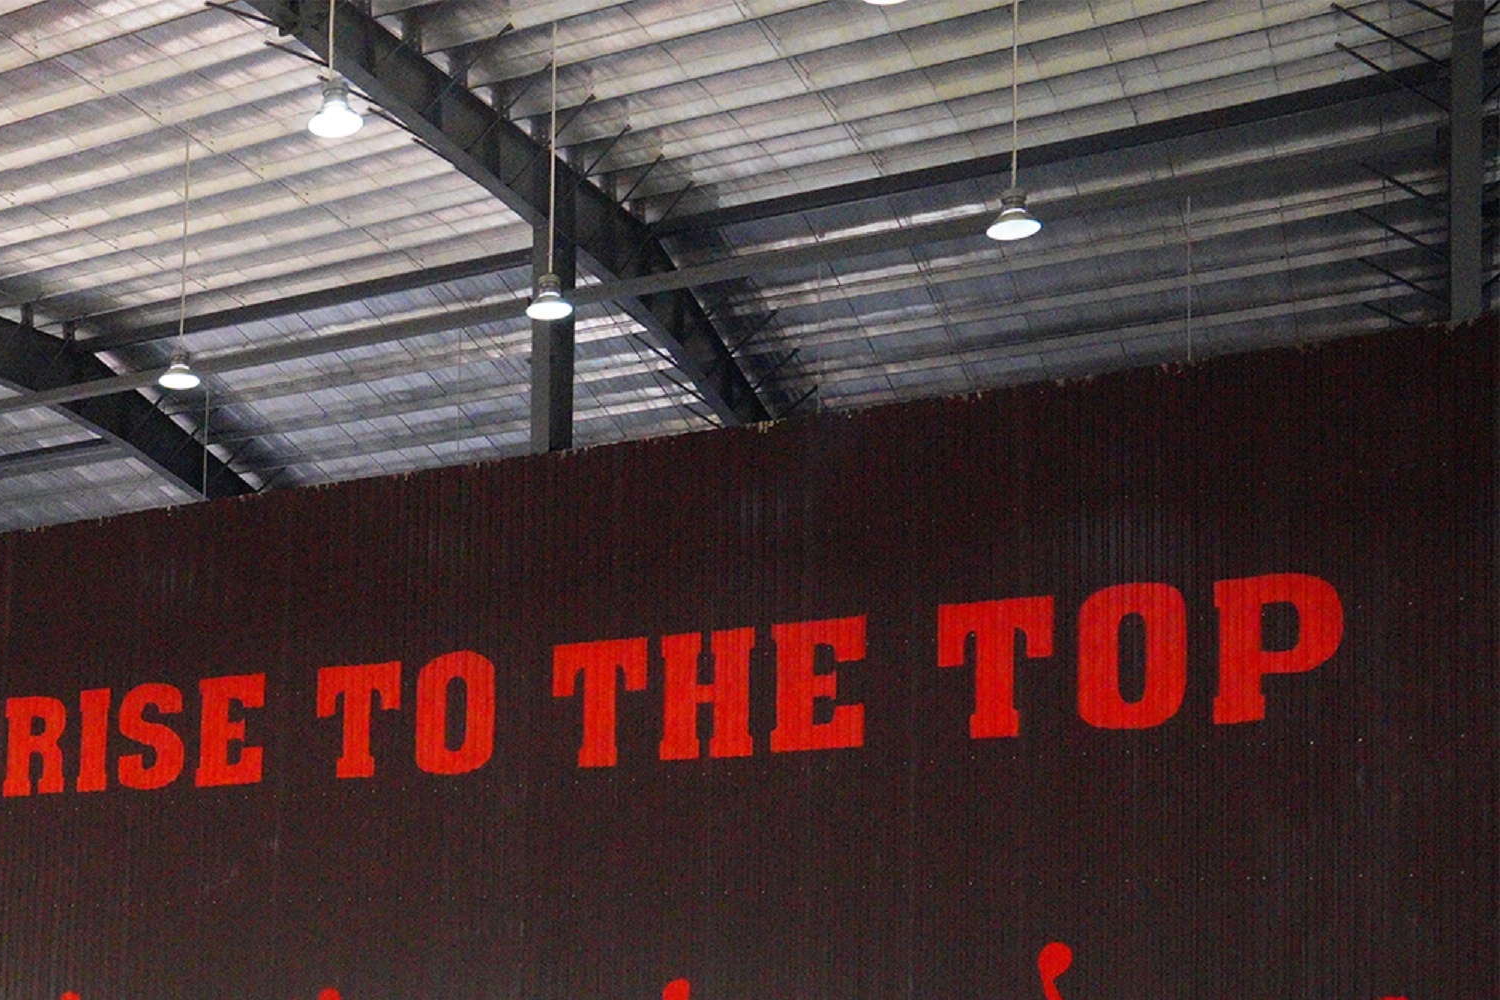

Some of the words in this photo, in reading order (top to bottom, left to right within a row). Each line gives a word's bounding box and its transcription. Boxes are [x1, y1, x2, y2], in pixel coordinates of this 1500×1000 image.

[2, 672, 266, 798] RISE
[316, 649, 496, 779] TO
[551, 615, 866, 768] THE
[937, 573, 1344, 739] TOP
